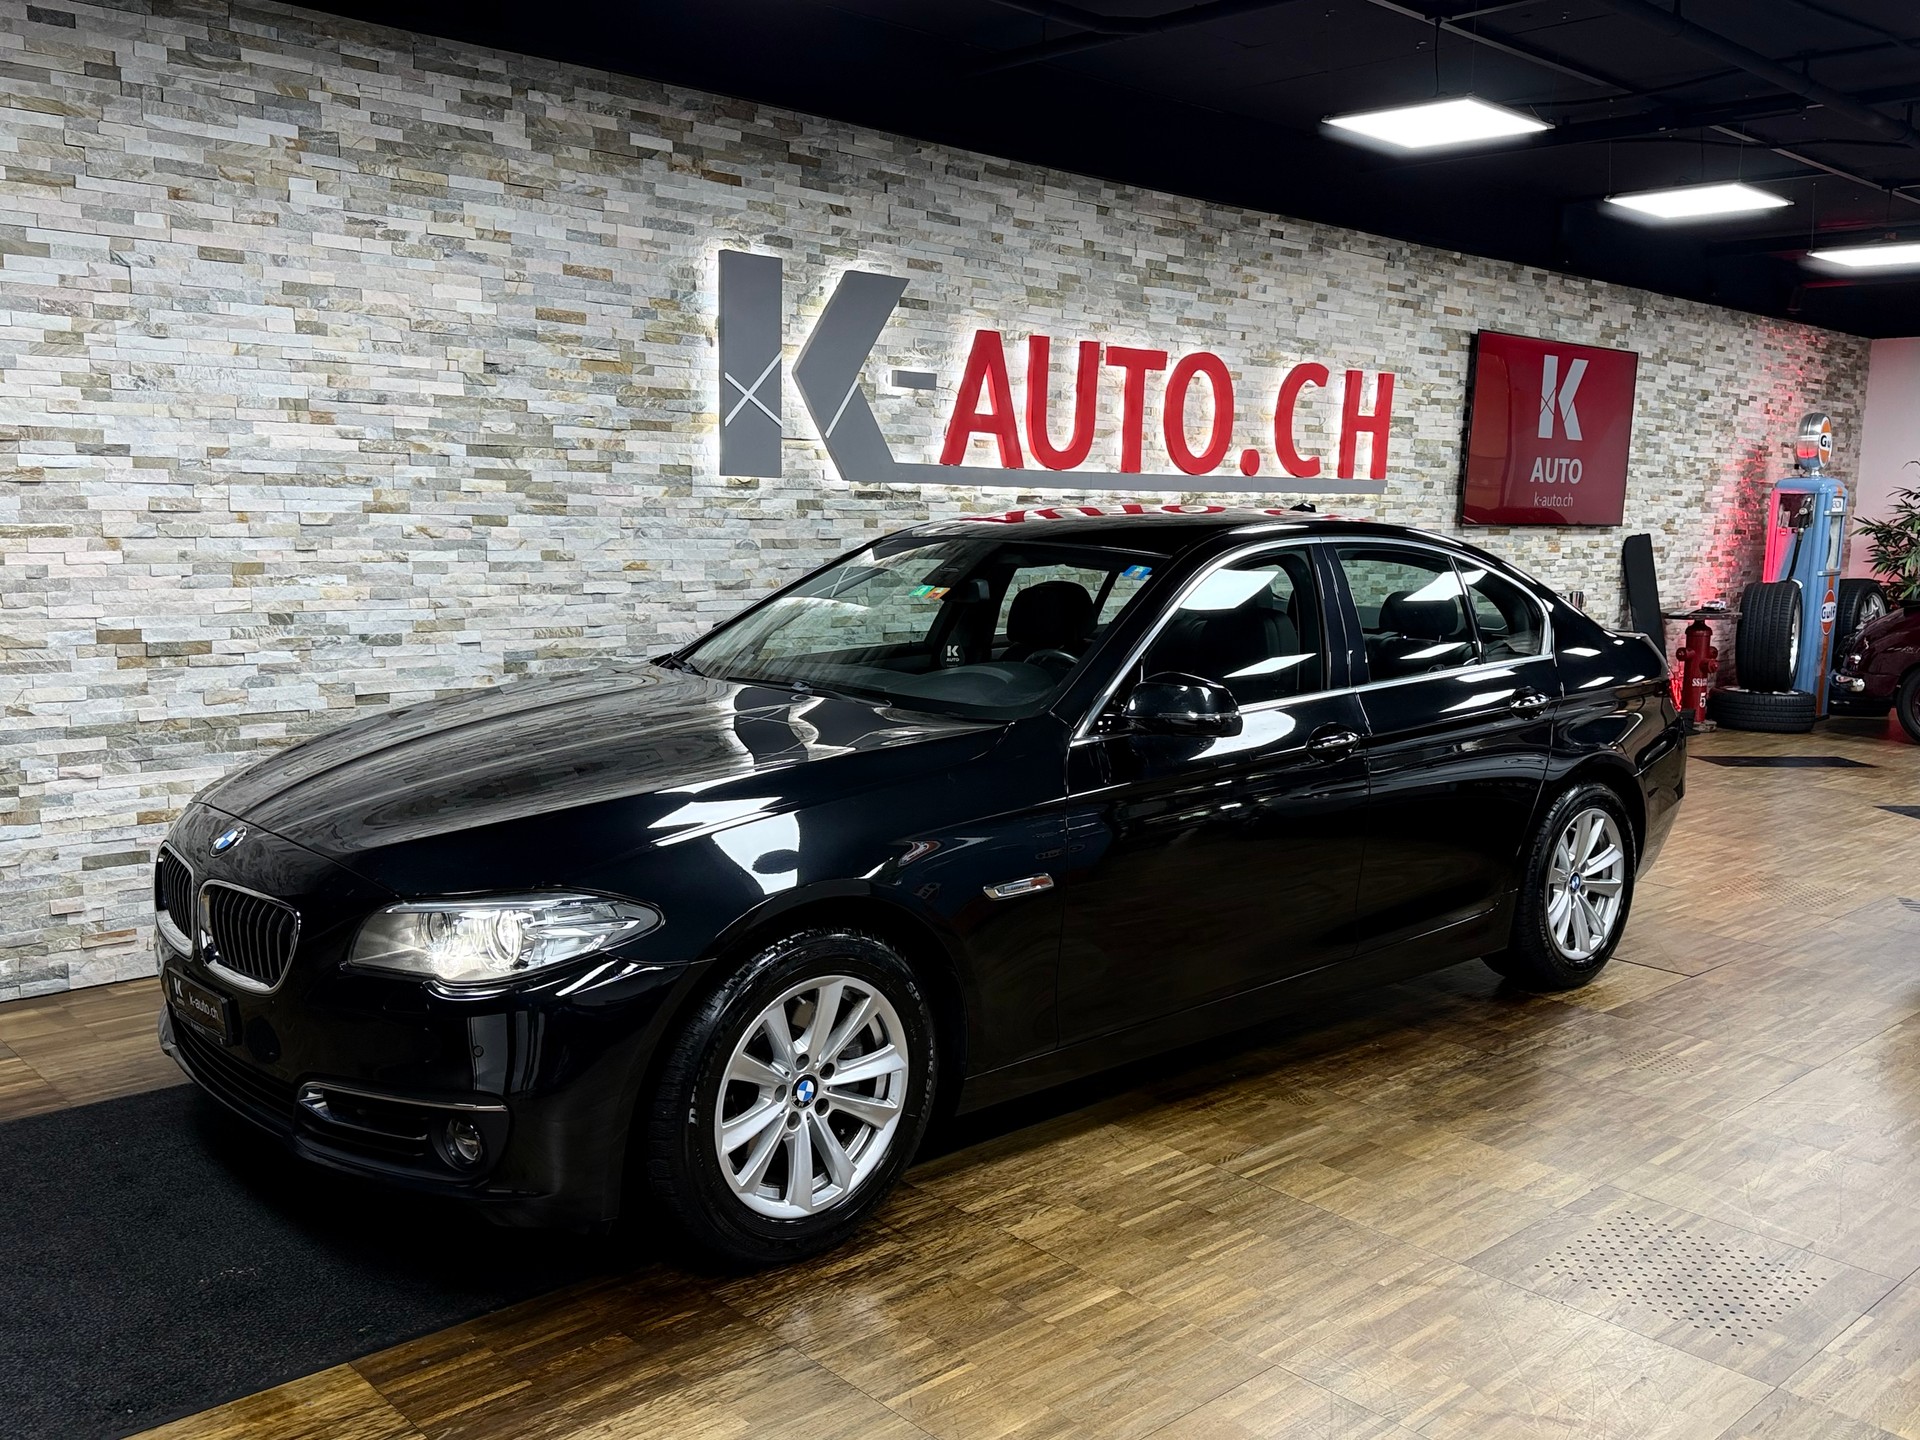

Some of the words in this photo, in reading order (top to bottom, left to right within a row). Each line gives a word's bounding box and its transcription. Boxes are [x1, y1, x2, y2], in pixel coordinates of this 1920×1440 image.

[1537, 354, 1589, 441] K
[1530, 456, 1583, 485] AUTO
[1533, 491, 1574, 508] k-auto.ch
[1821, 606, 1836, 620] Gulf
[947, 645, 959, 656] K
[1699, 692, 1707, 709] 5
